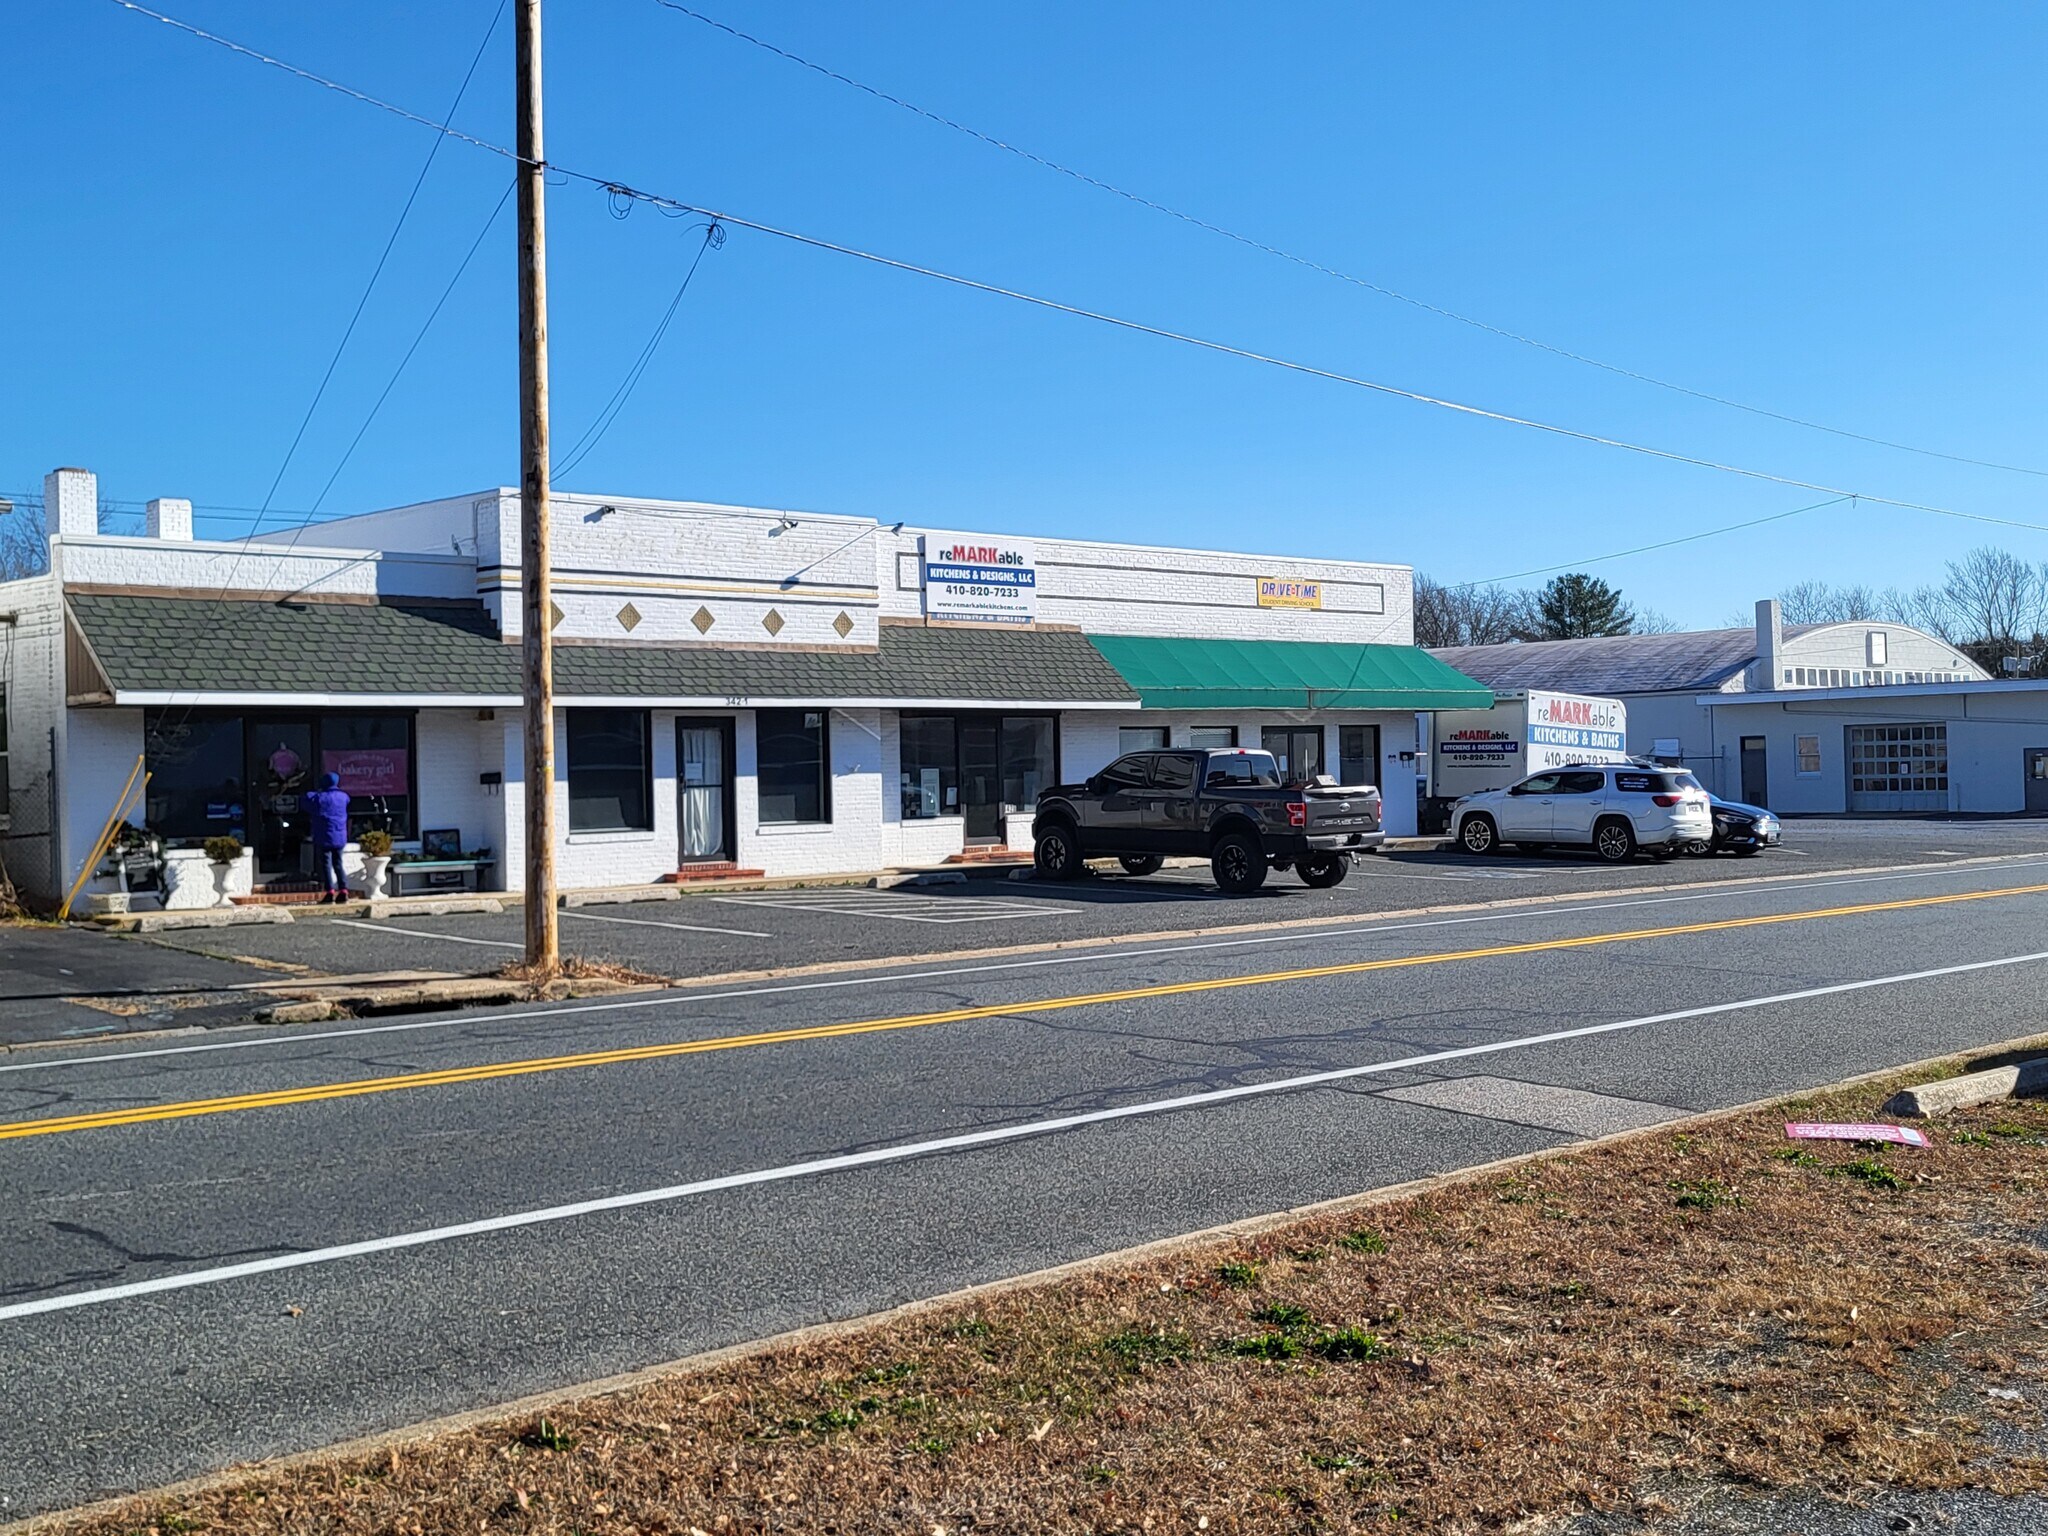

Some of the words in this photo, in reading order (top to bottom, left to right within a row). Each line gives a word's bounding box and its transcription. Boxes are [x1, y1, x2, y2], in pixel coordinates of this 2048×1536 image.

[939, 545, 1024, 565] reMARKable
[930, 567, 971, 580] KITCHENS
[972, 570, 979, 580] &
[980, 571, 1017, 583] DESIGNS,
[1018, 573, 1033, 583] LLC
[945, 585, 1019, 598] 410-820-7233
[1537, 699, 1616, 728] reMARKable
[1449, 730, 1510, 741] reMARKable
[1534, 727, 1579, 745] KITCHENS
[1581, 731, 1589, 746] &
[1591, 732, 1620, 749] BATHS
[337, 762, 375, 778] bakery
[376, 762, 395, 777] girl
